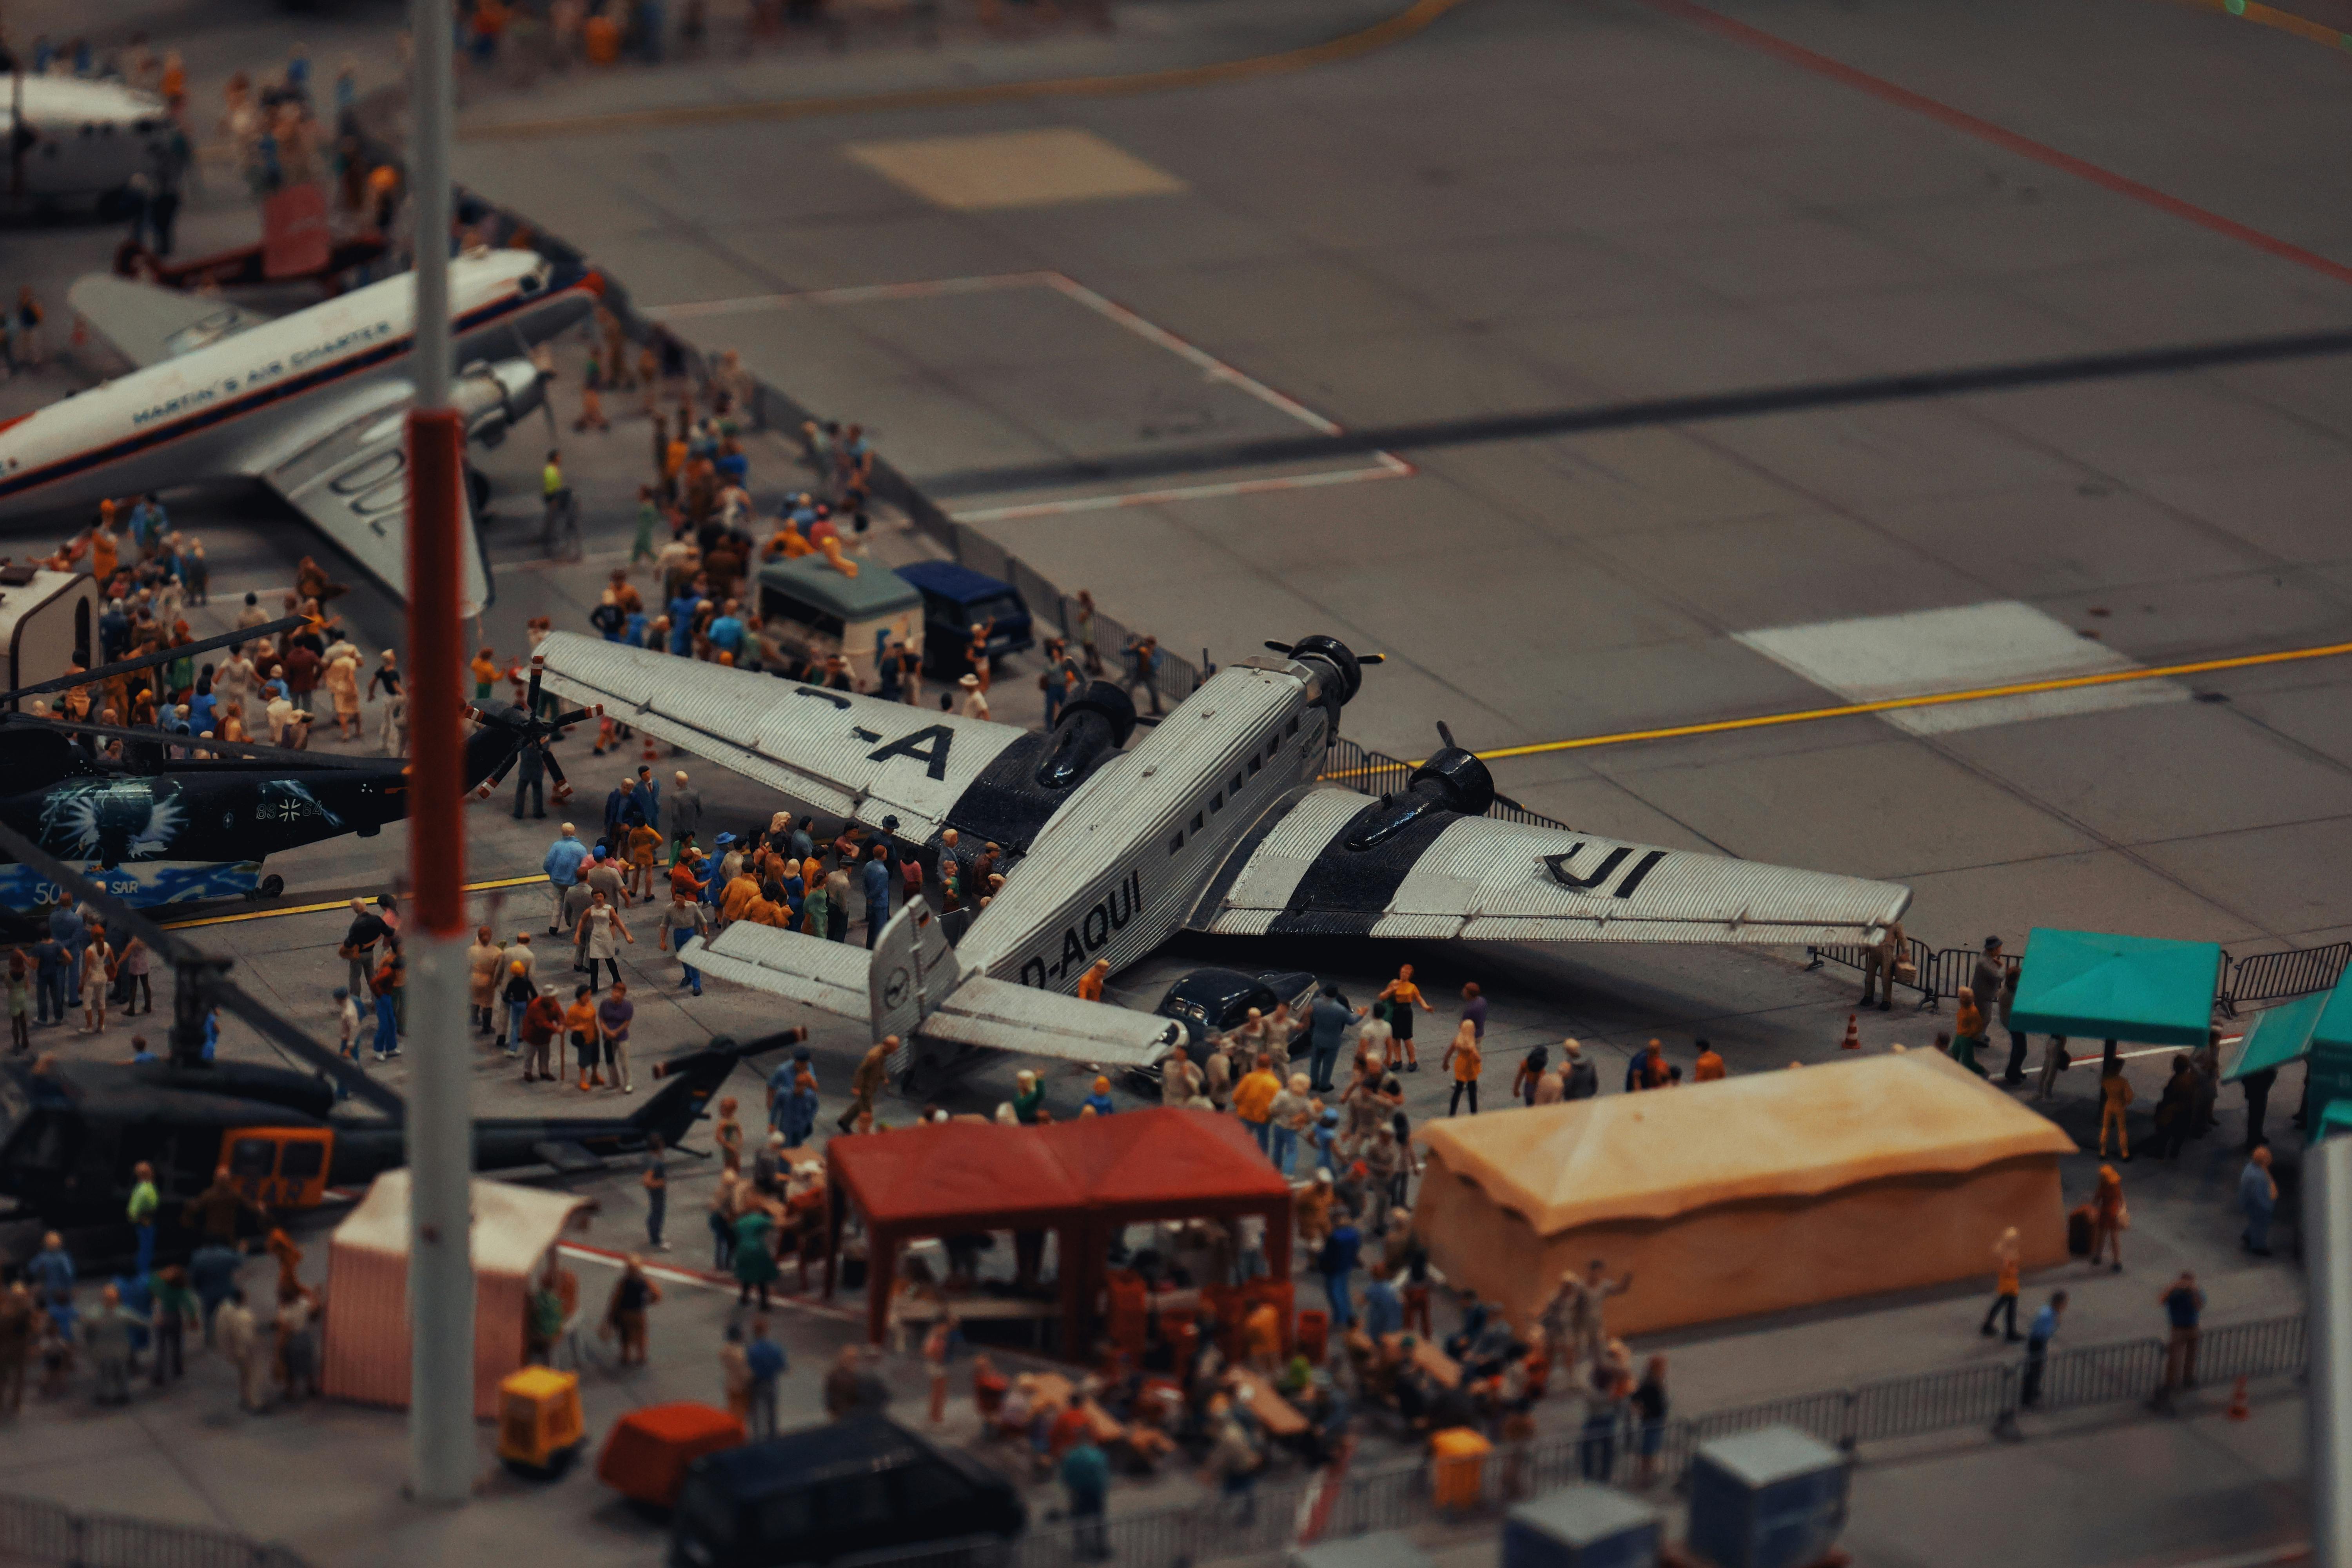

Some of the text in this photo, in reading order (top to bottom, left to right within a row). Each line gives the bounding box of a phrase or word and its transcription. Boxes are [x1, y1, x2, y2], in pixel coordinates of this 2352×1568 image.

[248, 361, 283, 382] AIR
[291, 319, 390, 366] CHARTER
[256, 800, 323, 820] 89 64
[33, 881, 138, 905] 50 SAR
[1022, 869, 1142, 989] D-AQUI
